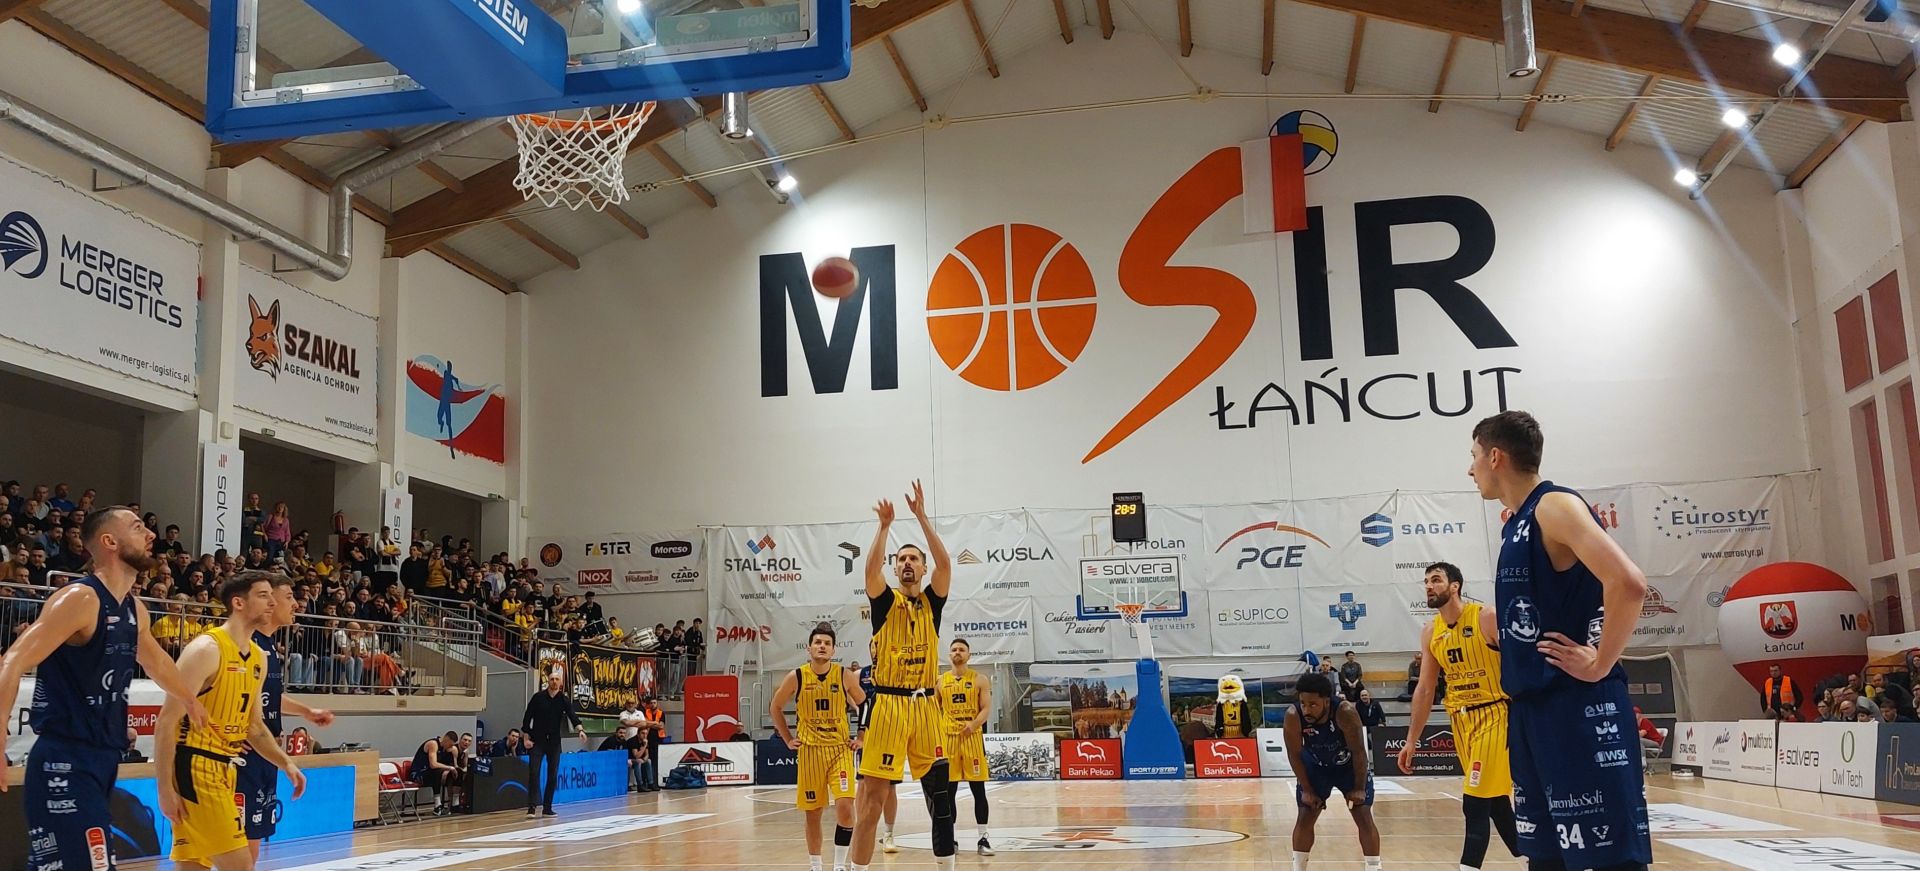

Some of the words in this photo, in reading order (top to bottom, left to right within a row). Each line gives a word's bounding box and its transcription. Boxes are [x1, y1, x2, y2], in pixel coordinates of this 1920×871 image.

[61, 234, 164, 296] MERGER
[60, 262, 183, 329] LOGISTICS
[284, 323, 361, 379] SZAKAL
[99, 345, 191, 384] www.merger-logistics.pl
[284, 364, 322, 383] AGENCJA
[324, 376, 361, 395] OCHRONY
[1210, 367, 1522, 430] ŁAŃCUT
[1671, 508, 1769, 526] Eurostyr
[1402, 521, 1466, 535] SAGAT
[1513, 519, 1531, 543] 34
[585, 541, 631, 556] FASTER
[655, 545, 688, 555] Moreso
[724, 557, 802, 572] STAL-ROL
[1237, 545, 1306, 570] PGE
[671, 571, 699, 580] CZADO
[1103, 561, 1172, 576] solvera
[579, 571, 610, 582] INOX
[760, 573, 802, 582] MICHNO
[1233, 607, 1289, 621] SUPICO
[954, 620, 1027, 631] HYDROTECH
[1065, 620, 1108, 634] Pasierb
[1764, 641, 1804, 653] Łańcut
[1446, 647, 1465, 664] 31
[815, 698, 830, 711] 10
[952, 693, 966, 703] 29
[127, 714, 148, 727] Bank
[1385, 739, 1422, 749] AKCS
[1431, 739, 1454, 748] DAC
[882, 753, 894, 766] 17
[1786, 745, 1820, 767] solvera
[570, 766, 597, 789] Pekao
[1068, 767, 1088, 776] Bank
[1089, 767, 1115, 776] Pekao
[1204, 767, 1226, 775] Bank
[1226, 766, 1253, 775] Pekao
[1832, 768, 1845, 786] Owl
[1846, 769, 1864, 788] Tech
[805, 790, 816, 800] 10
[1556, 823, 1586, 850] 34
